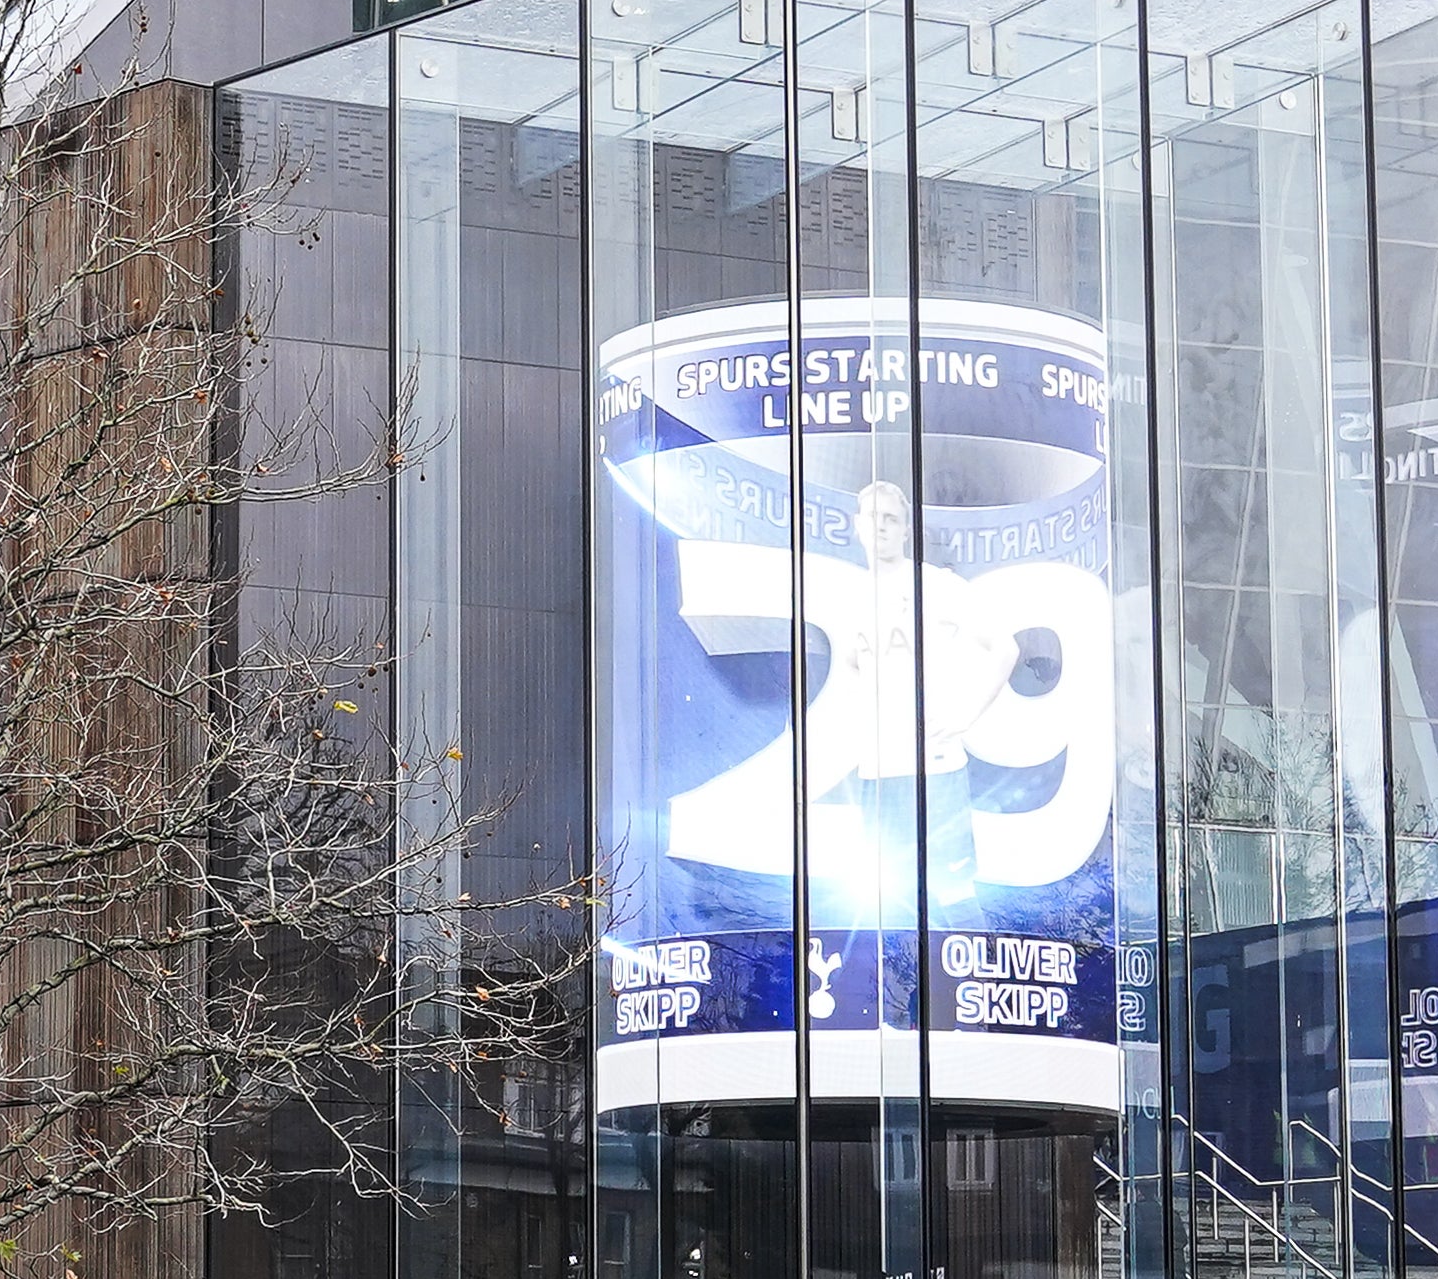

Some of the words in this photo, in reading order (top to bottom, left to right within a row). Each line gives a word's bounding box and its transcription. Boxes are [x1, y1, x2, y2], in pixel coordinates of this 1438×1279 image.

[677, 352, 791, 400] SPURS
[804, 348, 999, 389] STARTING
[861, 389, 910, 424] UP
[667, 538, 1114, 888] 29
[612, 940, 712, 992] OLIVER
[941, 934, 1078, 985] OLIVER
[616, 986, 701, 1036] SKIPP
[955, 980, 1069, 1029] SKIPP
